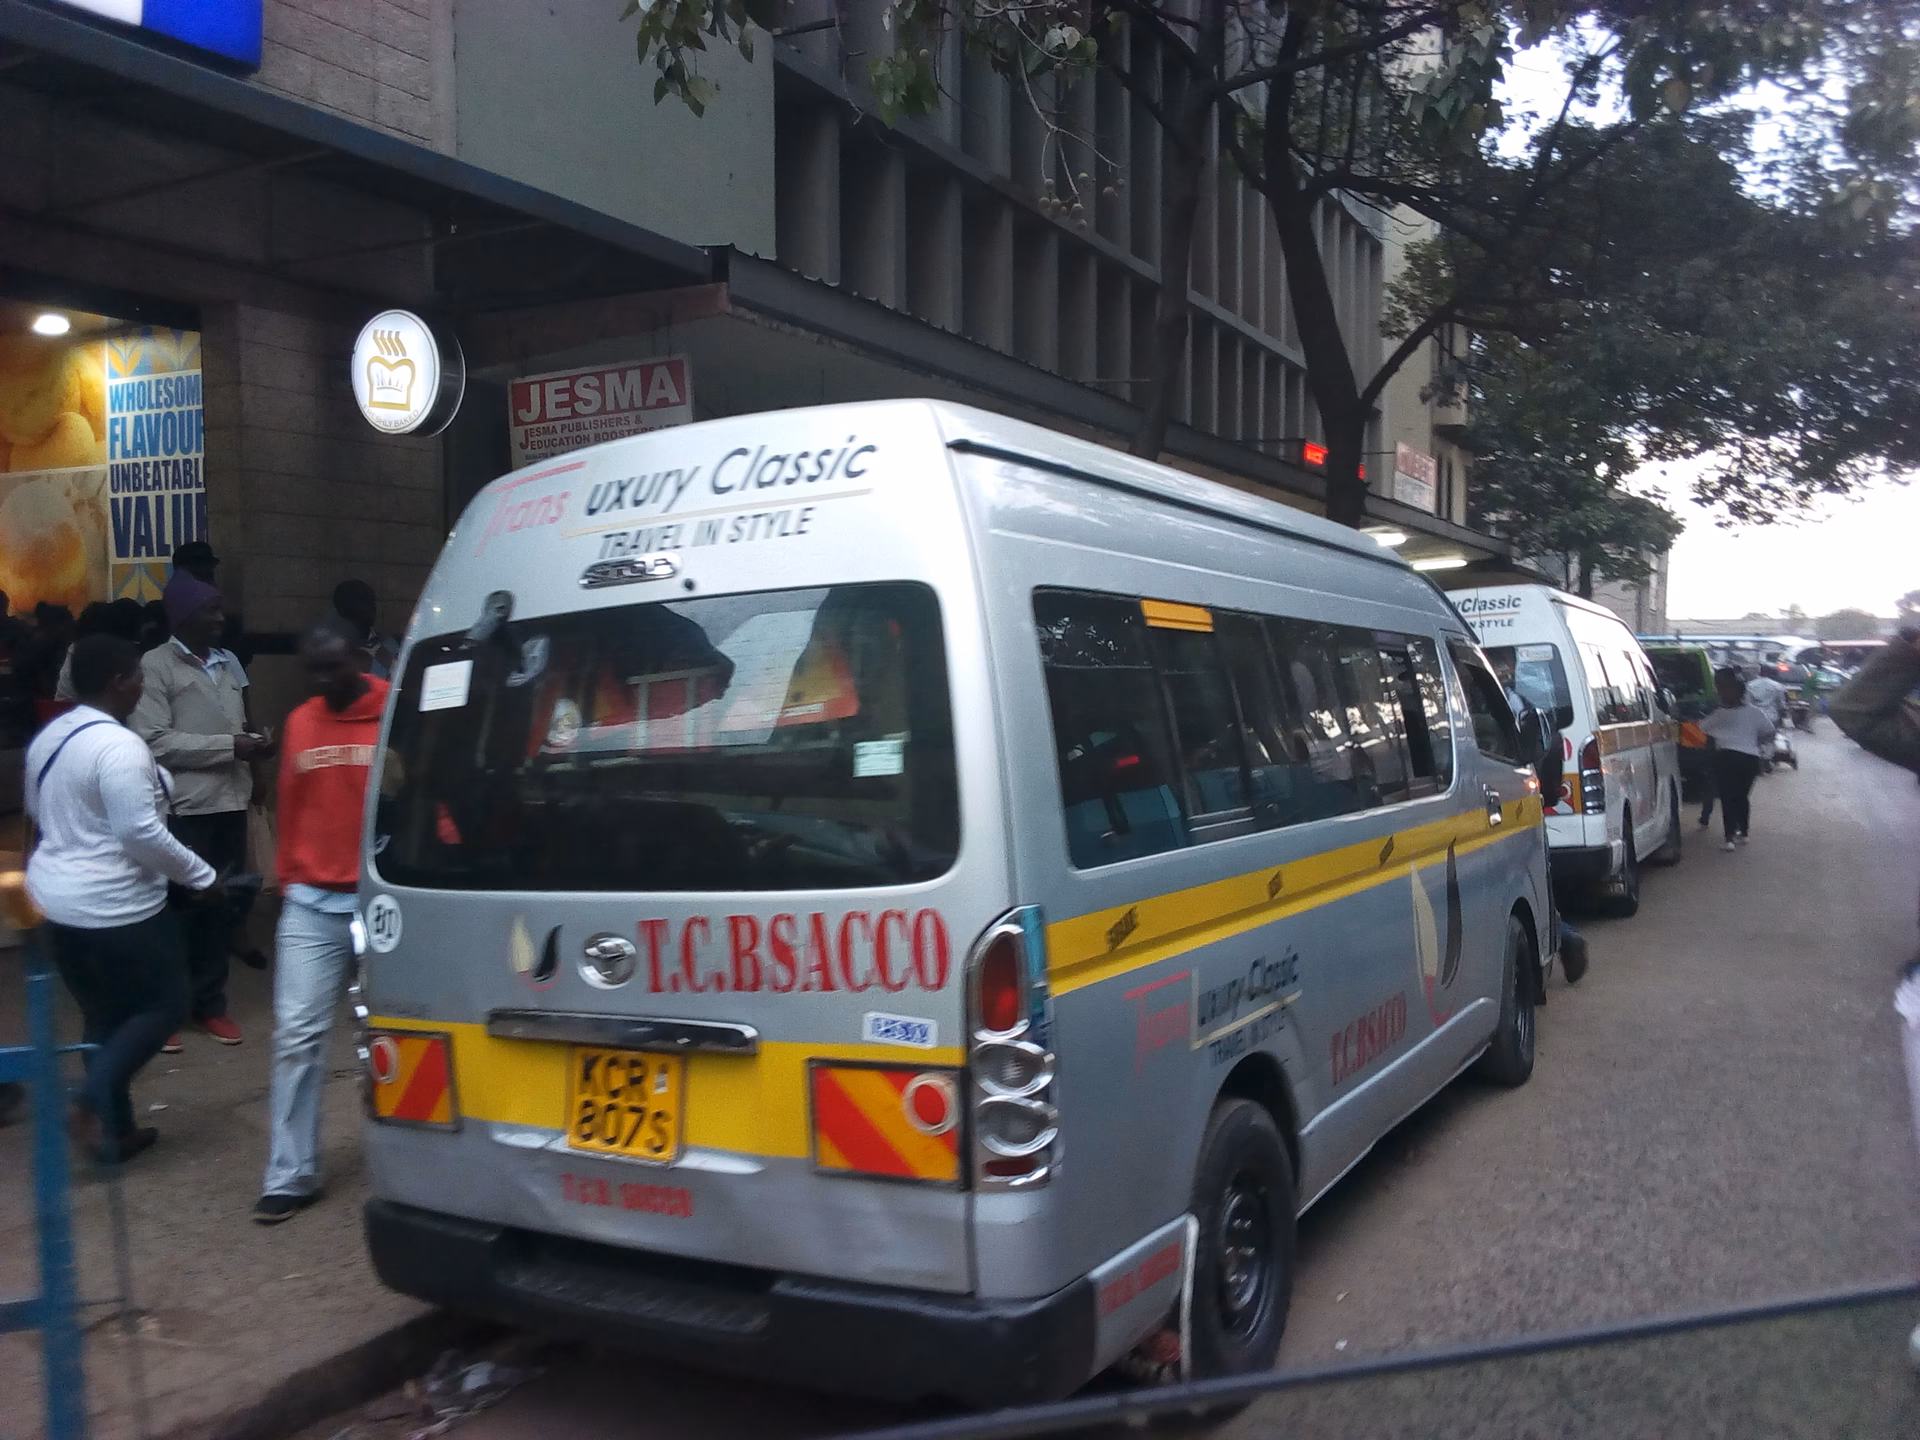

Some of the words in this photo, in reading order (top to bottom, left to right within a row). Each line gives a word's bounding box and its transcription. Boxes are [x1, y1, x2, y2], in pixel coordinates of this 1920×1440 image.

[518, 365, 681, 422] JESMA
[561, 416, 630, 434] PUBLISHERS
[634, 414, 643, 425] &
[531, 433, 590, 450] EDUCATION
[711, 435, 877, 495] Classic
[727, 507, 816, 543] STYLE
[1462, 595, 1522, 612] Classic
[1479, 618, 1514, 629] STYLE
